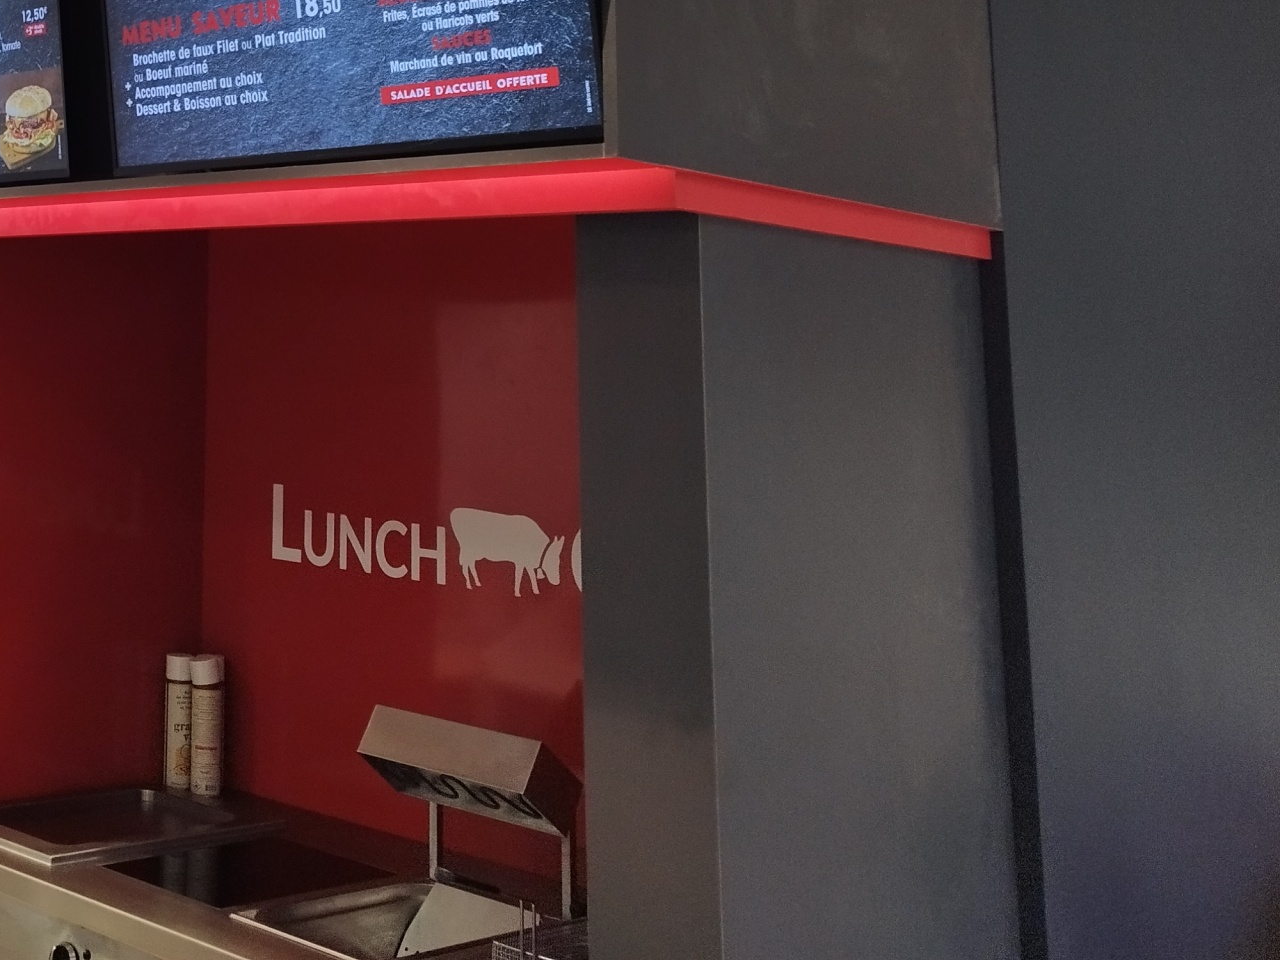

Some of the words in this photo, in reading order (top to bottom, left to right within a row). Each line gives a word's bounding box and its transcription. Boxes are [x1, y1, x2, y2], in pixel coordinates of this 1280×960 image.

[422, 22, 433, 32] ou
[476, 10, 500, 23] verts
[444, 0, 456, 14] de
[122, 16, 182, 46] MENU
[132, 48, 176, 68] Brochette
[178, 44, 191, 59] de
[192, 42, 214, 58] faux
[216, 38, 240, 54] Filet
[241, 40, 252, 50] ou
[254, 33, 276, 49] Plat
[278, 26, 326, 45] Tradition
[390, 56, 438, 74] Marchand
[440, 53, 453, 66] de
[456, 52, 471, 64] vin
[475, 51, 488, 62] ou
[491, 42, 542, 60] Roquefort
[134, 72, 144, 83] ou
[146, 66, 172, 82] Boeuf
[174, 60, 208, 77] mariné
[134, 76, 218, 100] Accompagnement
[220, 78, 233, 89] au
[234, 71, 264, 87] choix
[390, 87, 430, 100] SALADE
[436, 80, 492, 96] D'ACCUEIL
[496, 74, 548, 88] OFFERTE
[136, 100, 172, 117] Dessert
[174, 99, 182, 112] &
[184, 93, 222, 111] Boisson
[224, 94, 238, 106] au
[240, 89, 268, 104] choix
